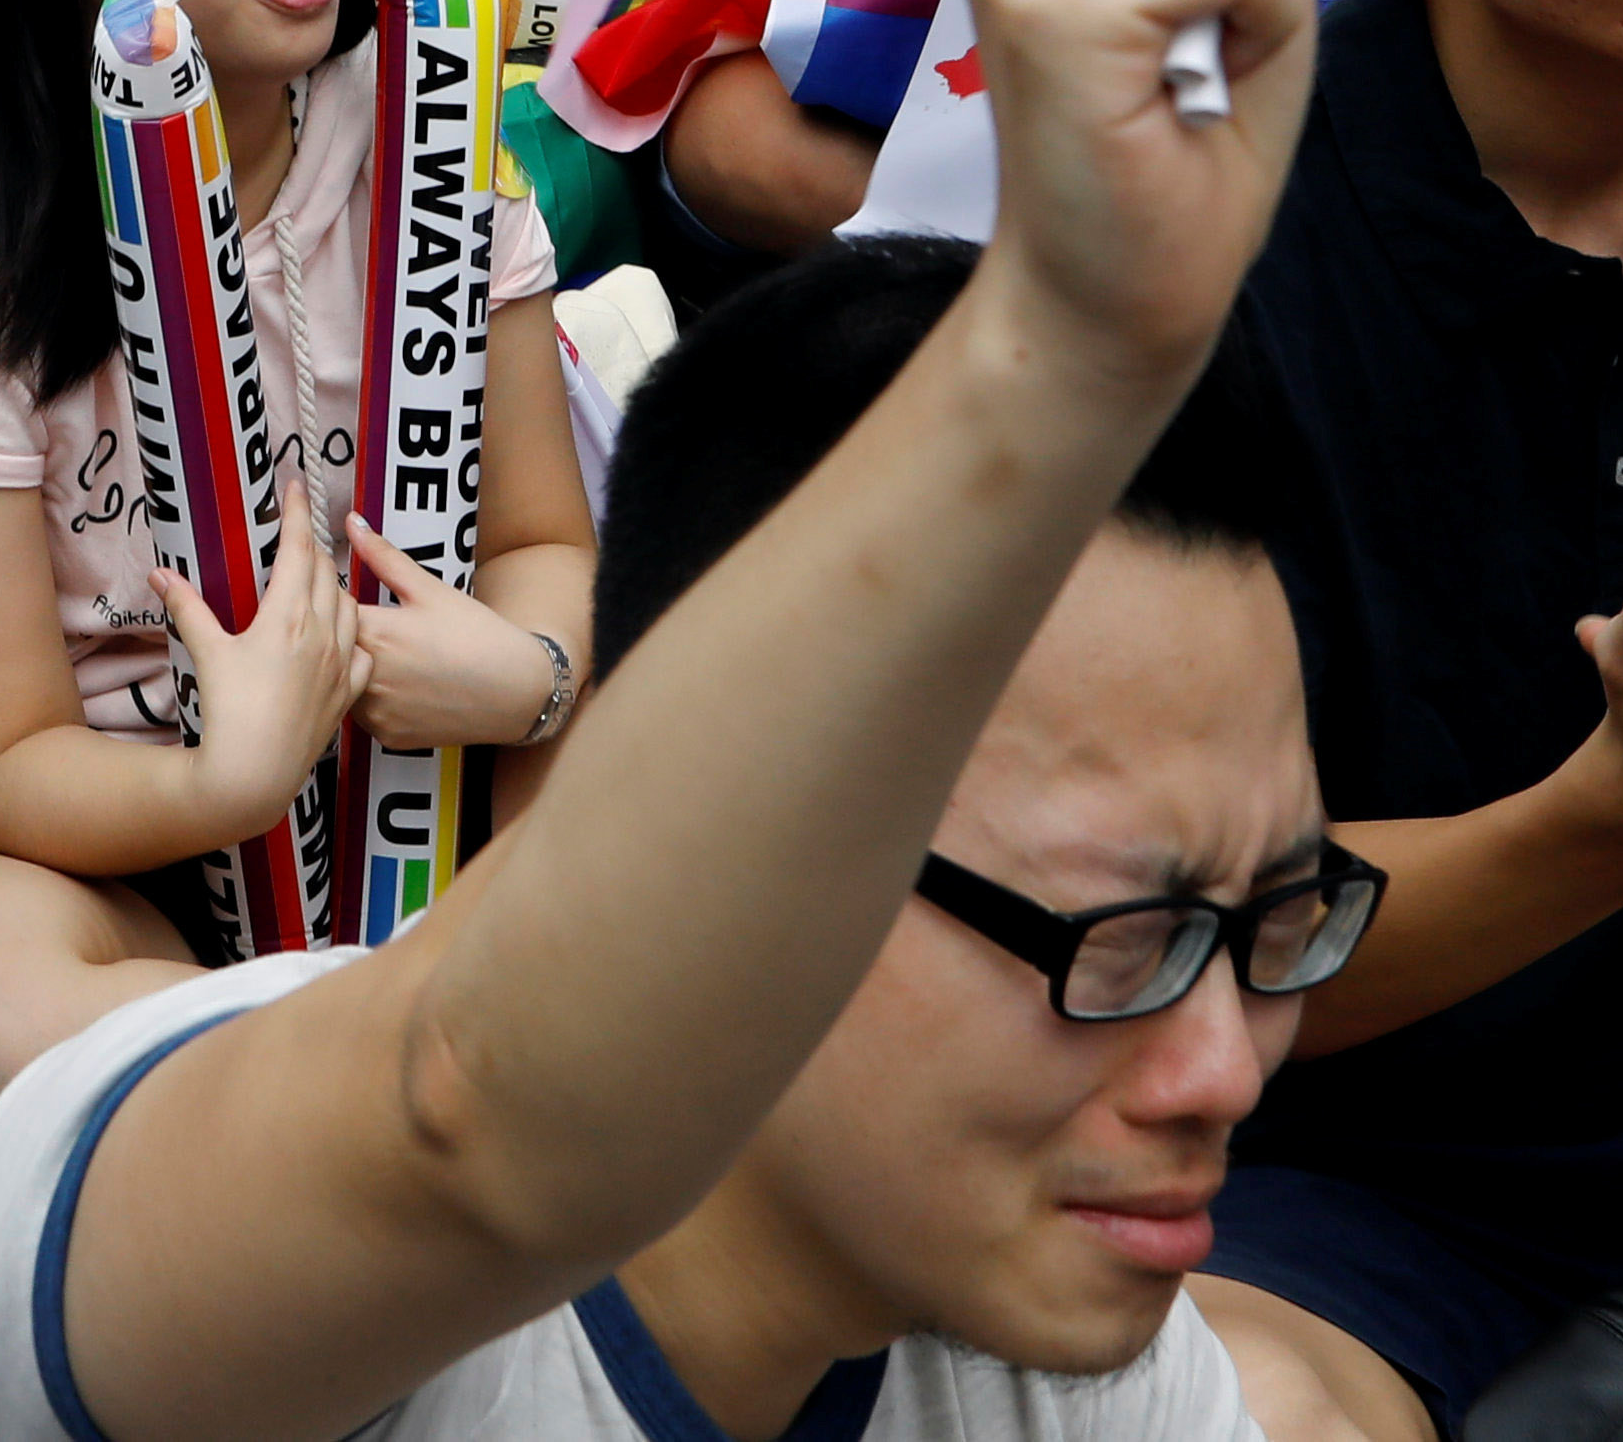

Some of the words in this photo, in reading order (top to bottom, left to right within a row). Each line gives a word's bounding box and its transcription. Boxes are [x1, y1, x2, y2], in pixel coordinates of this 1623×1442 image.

[401, 39, 470, 377] ALWAYS
[105, 243, 146, 304] U
[394, 406, 453, 513] BE
[376, 791, 433, 846] U
